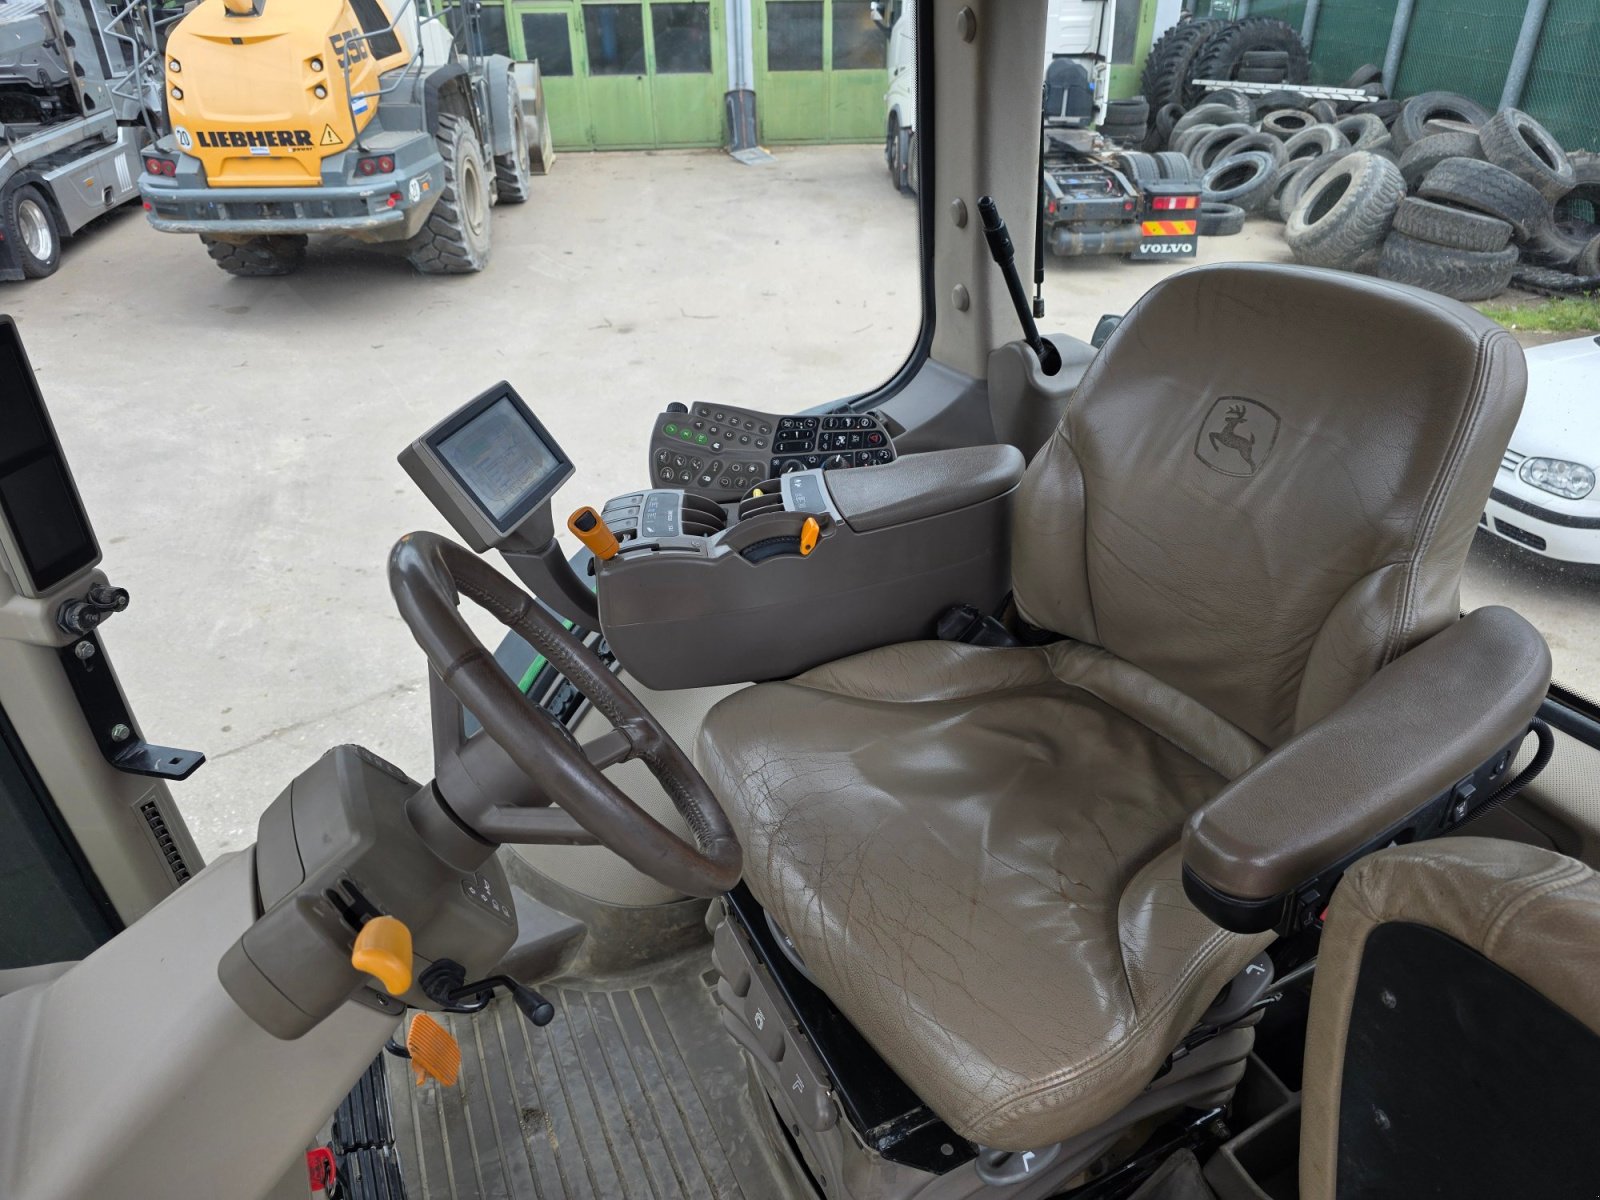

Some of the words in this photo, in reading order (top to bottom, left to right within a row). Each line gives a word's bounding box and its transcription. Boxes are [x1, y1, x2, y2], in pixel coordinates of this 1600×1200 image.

[176, 130, 191, 147] 20
[196, 129, 315, 148] LIEBHERR
[1139, 243, 1193, 254] VOLVO
